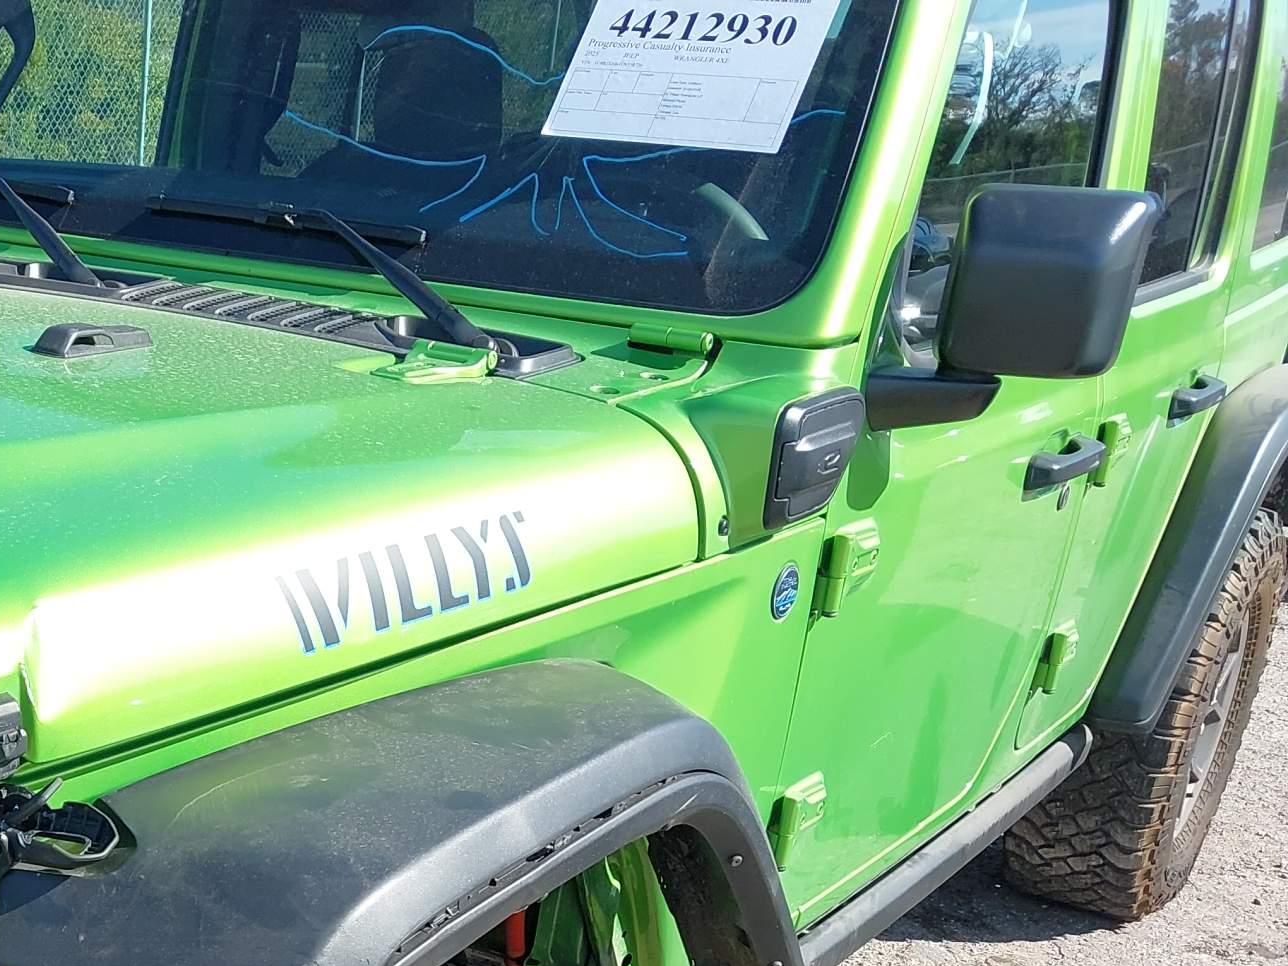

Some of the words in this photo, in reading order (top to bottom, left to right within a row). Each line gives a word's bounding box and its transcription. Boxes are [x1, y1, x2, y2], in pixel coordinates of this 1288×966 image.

[609, 8, 798, 46] 44212930
[588, 38, 641, 50] Progressive
[642, 41, 684, 53] Casualty
[685, 43, 732, 55] Insurance
[274, 511, 531, 653] WILLYS
